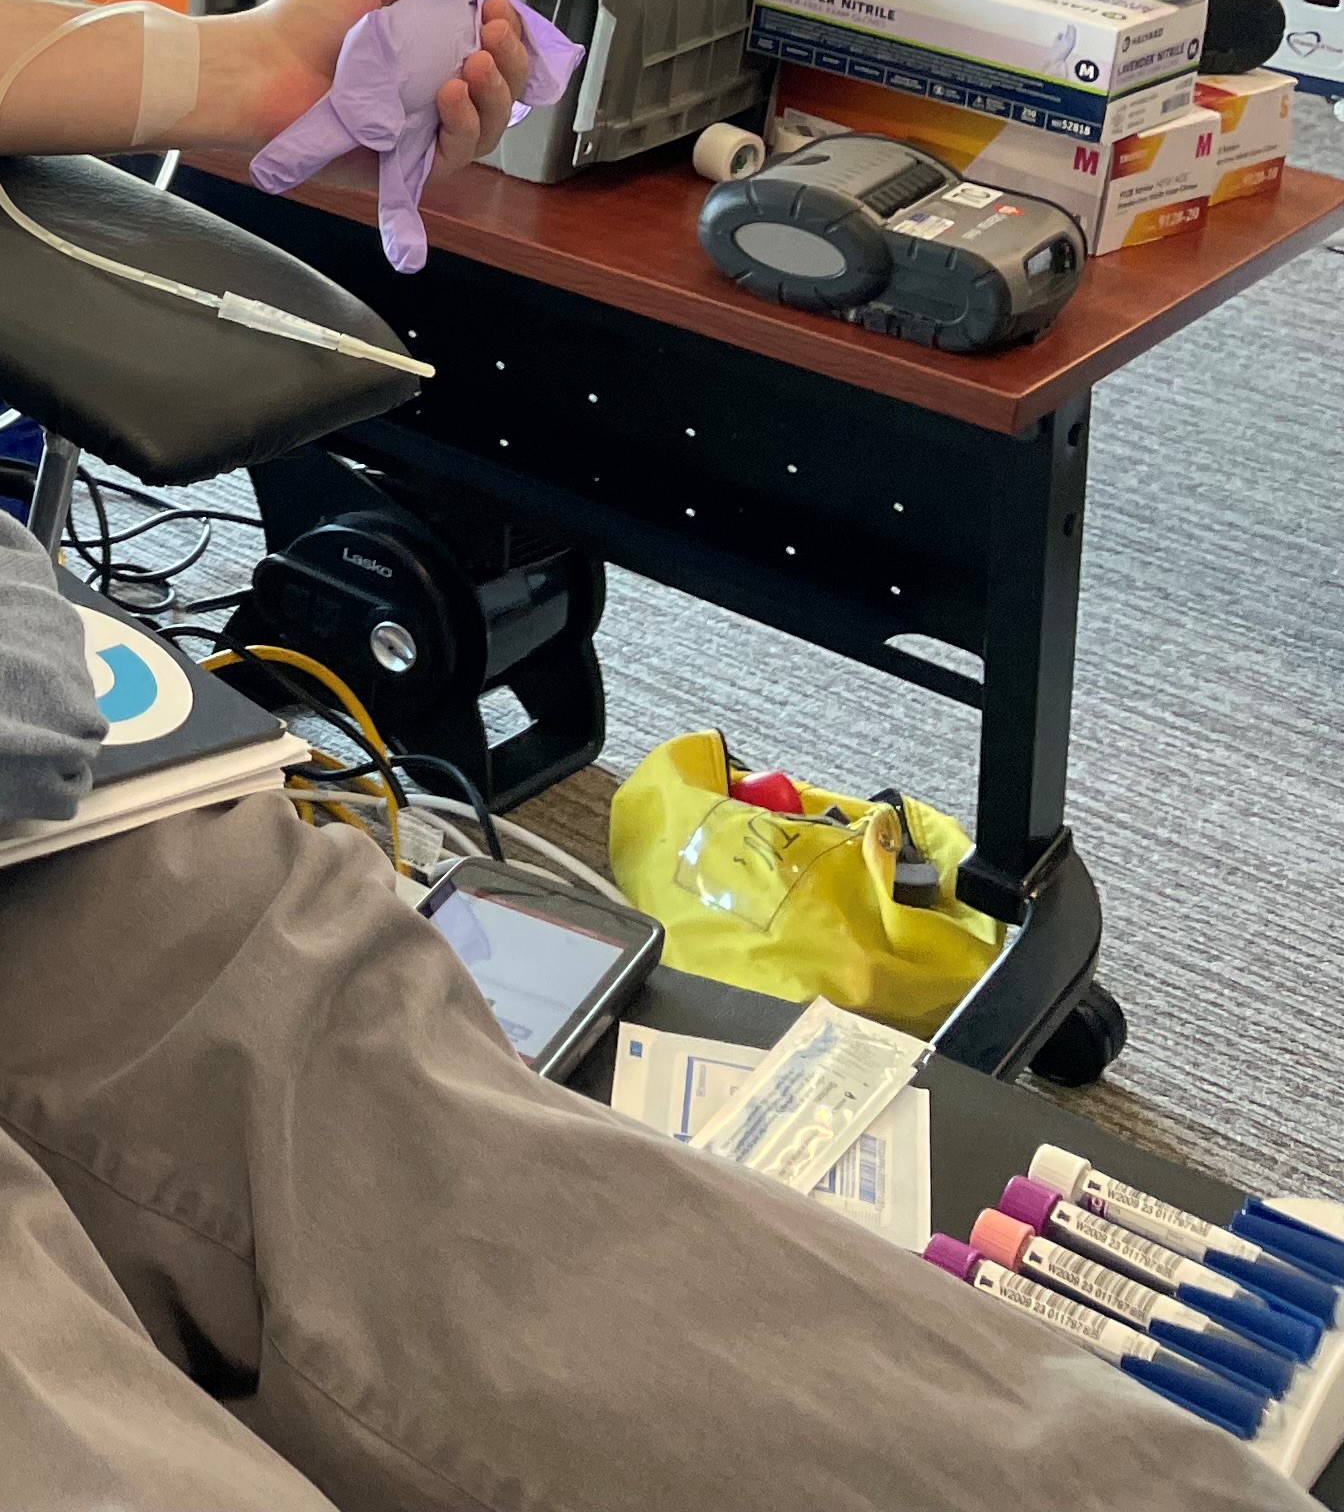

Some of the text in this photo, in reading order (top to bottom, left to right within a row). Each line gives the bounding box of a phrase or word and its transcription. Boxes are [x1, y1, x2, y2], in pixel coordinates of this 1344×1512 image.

[1079, 63, 1095, 80] M
[1117, 42, 1185, 77] LAVENDER NITRILE
[1073, 146, 1100, 176] M
[1195, 133, 1213, 159] M
[341, 547, 393, 579] Lasko
